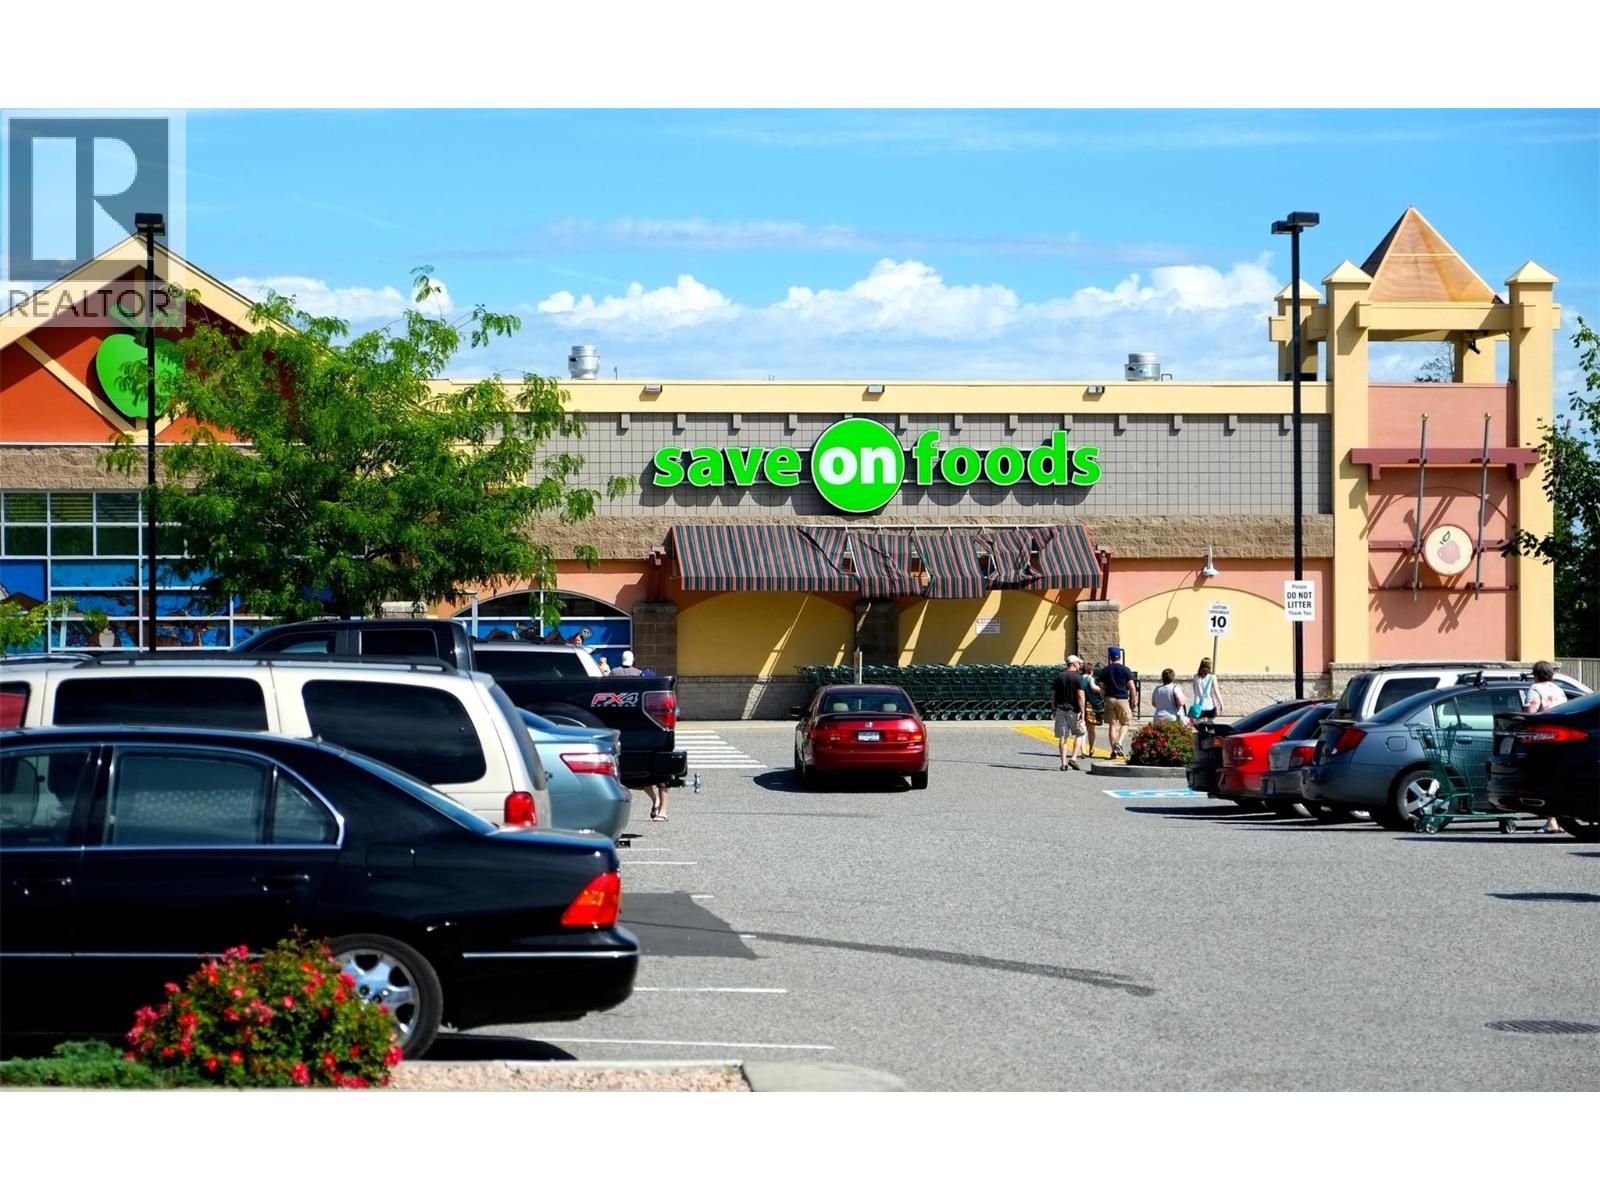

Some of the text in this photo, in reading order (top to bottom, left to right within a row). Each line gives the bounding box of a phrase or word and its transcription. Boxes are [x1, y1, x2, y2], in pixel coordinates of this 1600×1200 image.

[653, 430, 1102, 487] save on foods
[1286, 591, 1312, 599] DO NOT
[1210, 615, 1227, 628] 10
[592, 692, 639, 705] FX4
